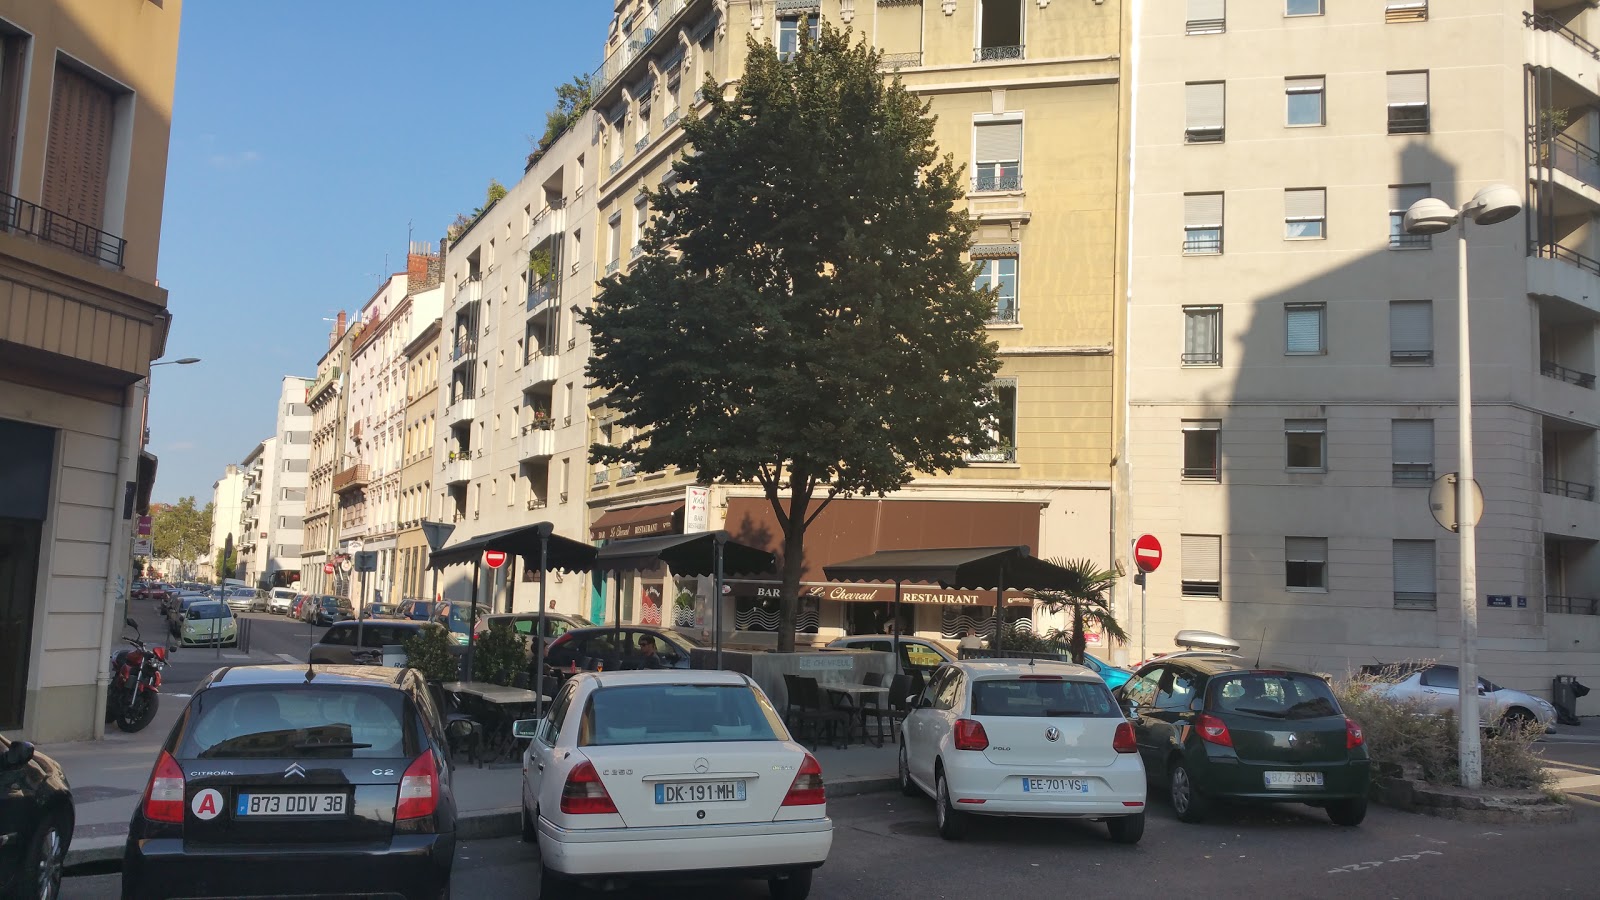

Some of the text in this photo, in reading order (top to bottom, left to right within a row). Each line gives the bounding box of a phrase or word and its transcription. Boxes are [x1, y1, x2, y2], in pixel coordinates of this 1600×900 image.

[635, 523, 658, 534] RESTAURANT
[757, 586, 979, 604] BAR Le Chevreul RESTAURANT
[190, 769, 235, 777] CITROËN
[371, 768, 394, 776] C2
[1030, 780, 1081, 791] EE-701-VS
[666, 784, 735, 802] DK-191-MH
[197, 793, 216, 814] A
[250, 796, 281, 812] 873
[285, 795, 318, 812] DDV
[323, 795, 343, 812] 38
